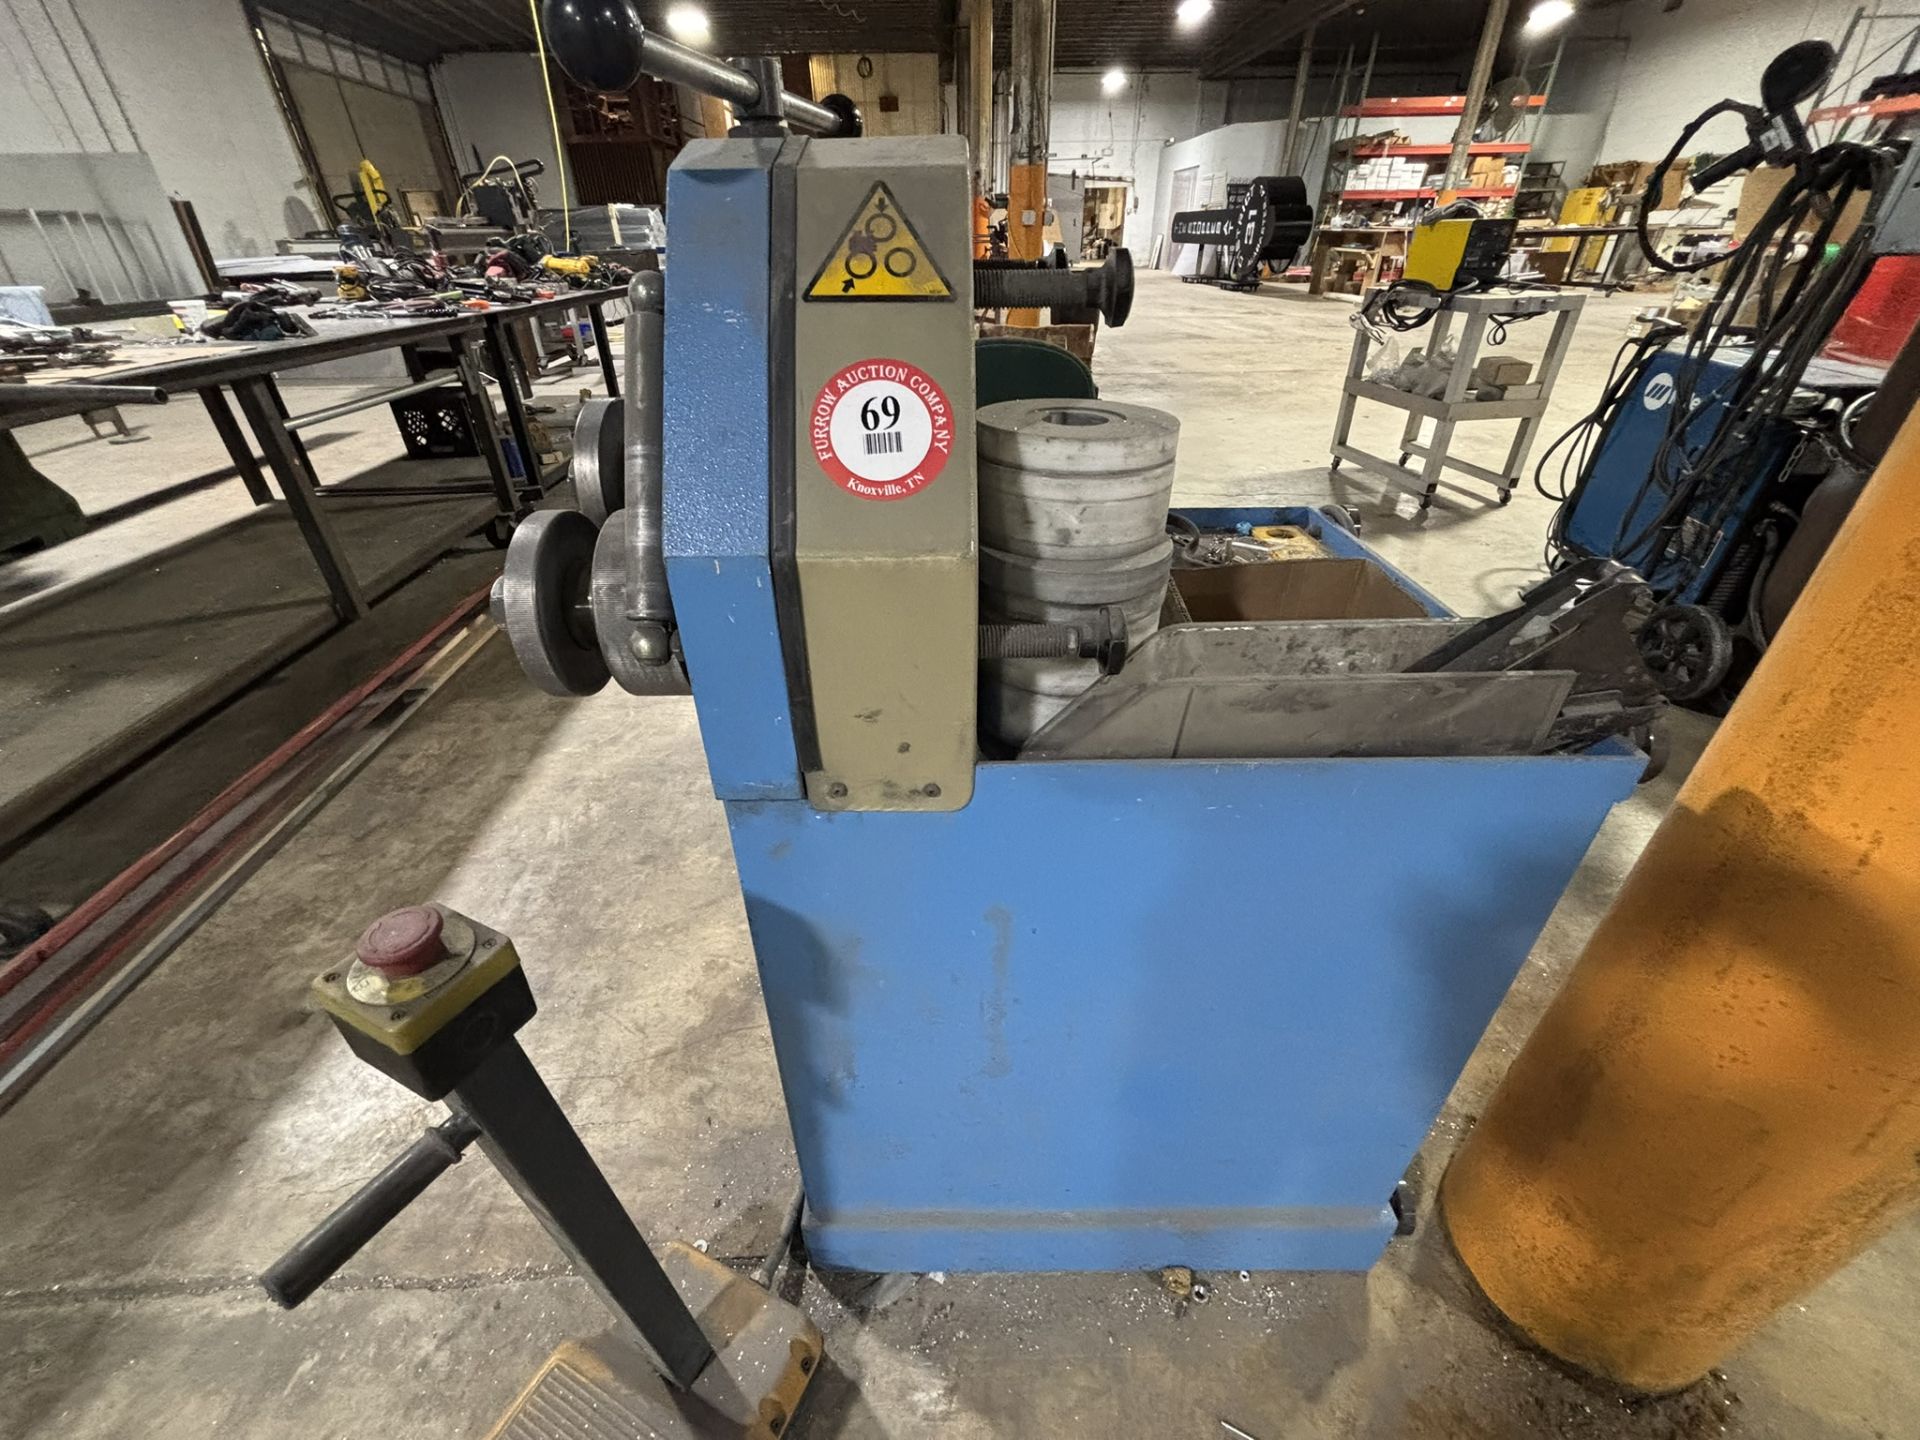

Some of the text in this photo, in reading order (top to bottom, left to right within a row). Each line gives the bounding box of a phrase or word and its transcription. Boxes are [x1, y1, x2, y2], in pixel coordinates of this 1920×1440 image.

[814, 365, 951, 461] FURROW AUCTION COMPANY
[860, 395, 901, 431] 69
[846, 472, 925, 496] Knoxville, TN
